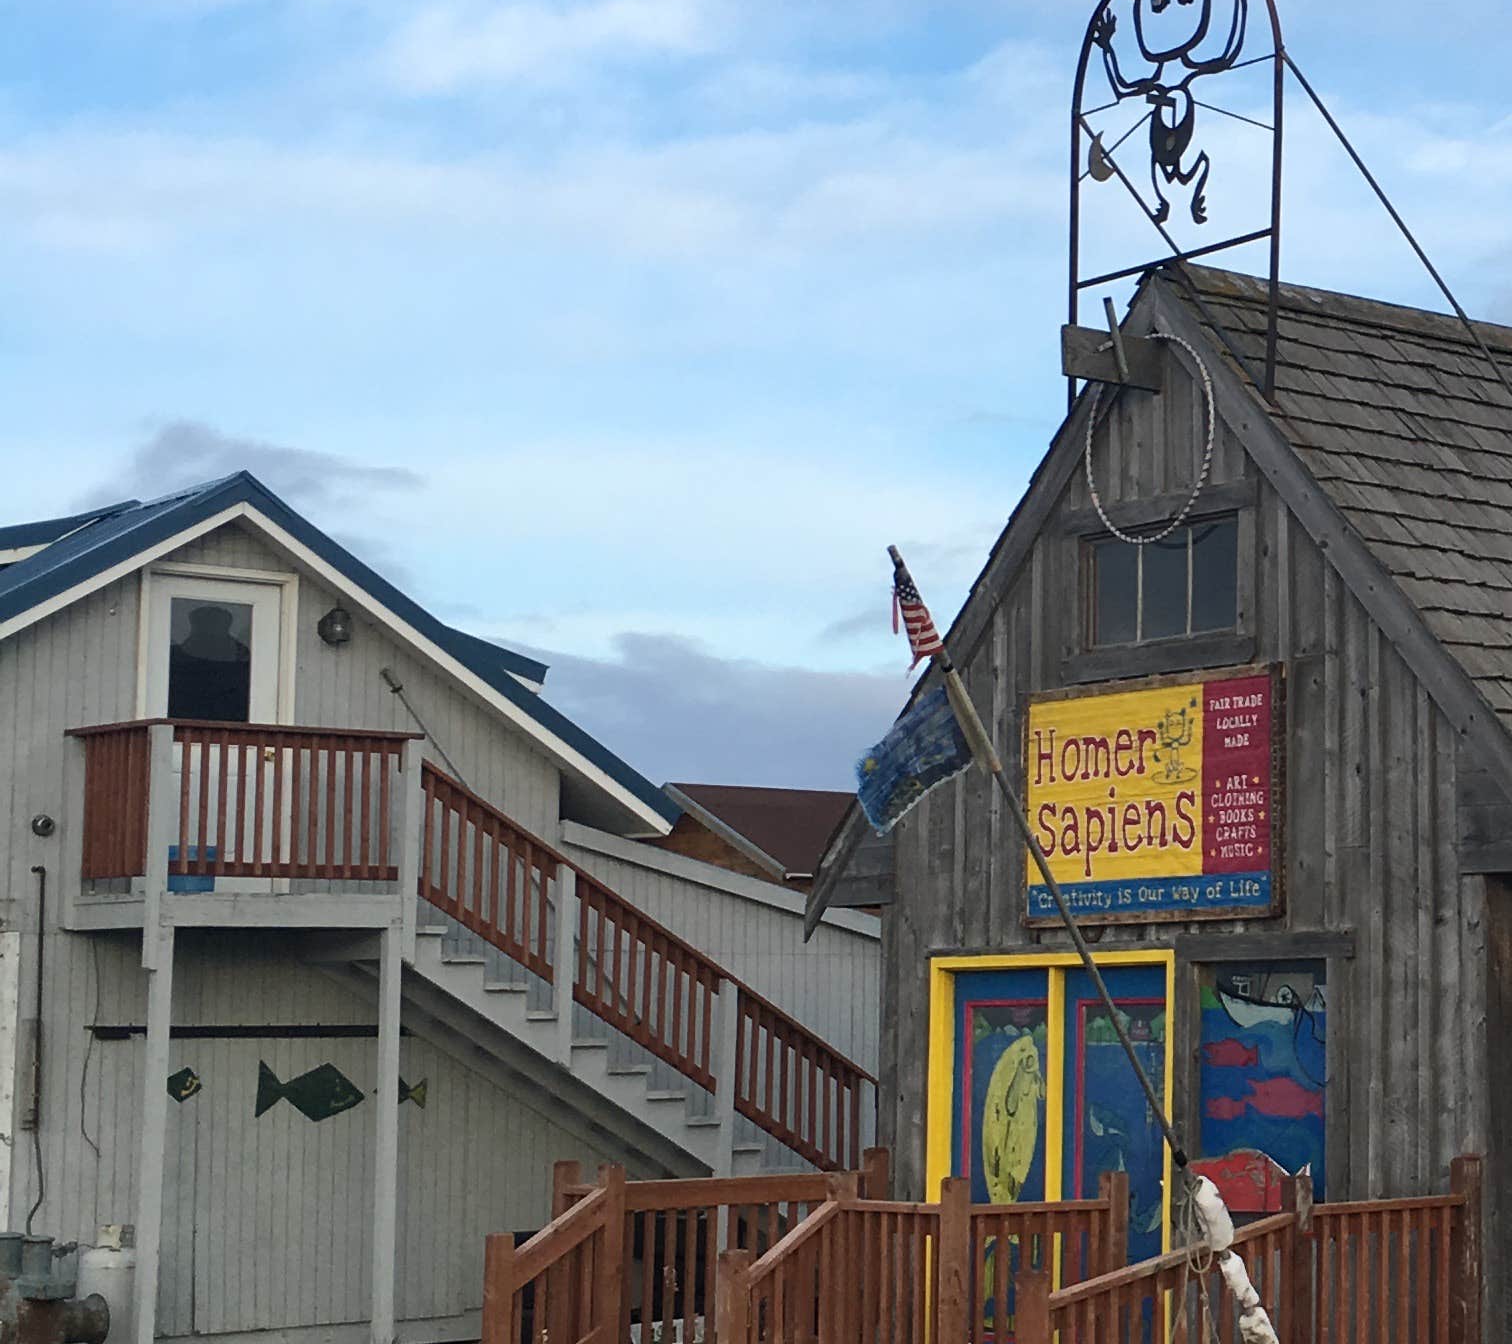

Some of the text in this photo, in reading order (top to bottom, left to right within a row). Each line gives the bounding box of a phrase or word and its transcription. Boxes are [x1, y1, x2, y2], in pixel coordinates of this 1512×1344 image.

[1209, 694, 1263, 711] FAIR TRADE
[1216, 714, 1258, 730] LOCALLY
[1224, 733, 1249, 748] MADE
[1034, 729, 1157, 785] Homer
[1226, 774, 1248, 790] ART
[1211, 791, 1264, 808] CLOTHING
[1219, 809, 1254, 824] BOOKS
[1215, 825, 1257, 842] CRAFTS
[1220, 843, 1254, 858] MUSIC
[1032, 889, 1112, 909] "Crativity
[1117, 887, 1131, 903] is
[1138, 885, 1165, 901] Our
[1206, 881, 1223, 899] of
